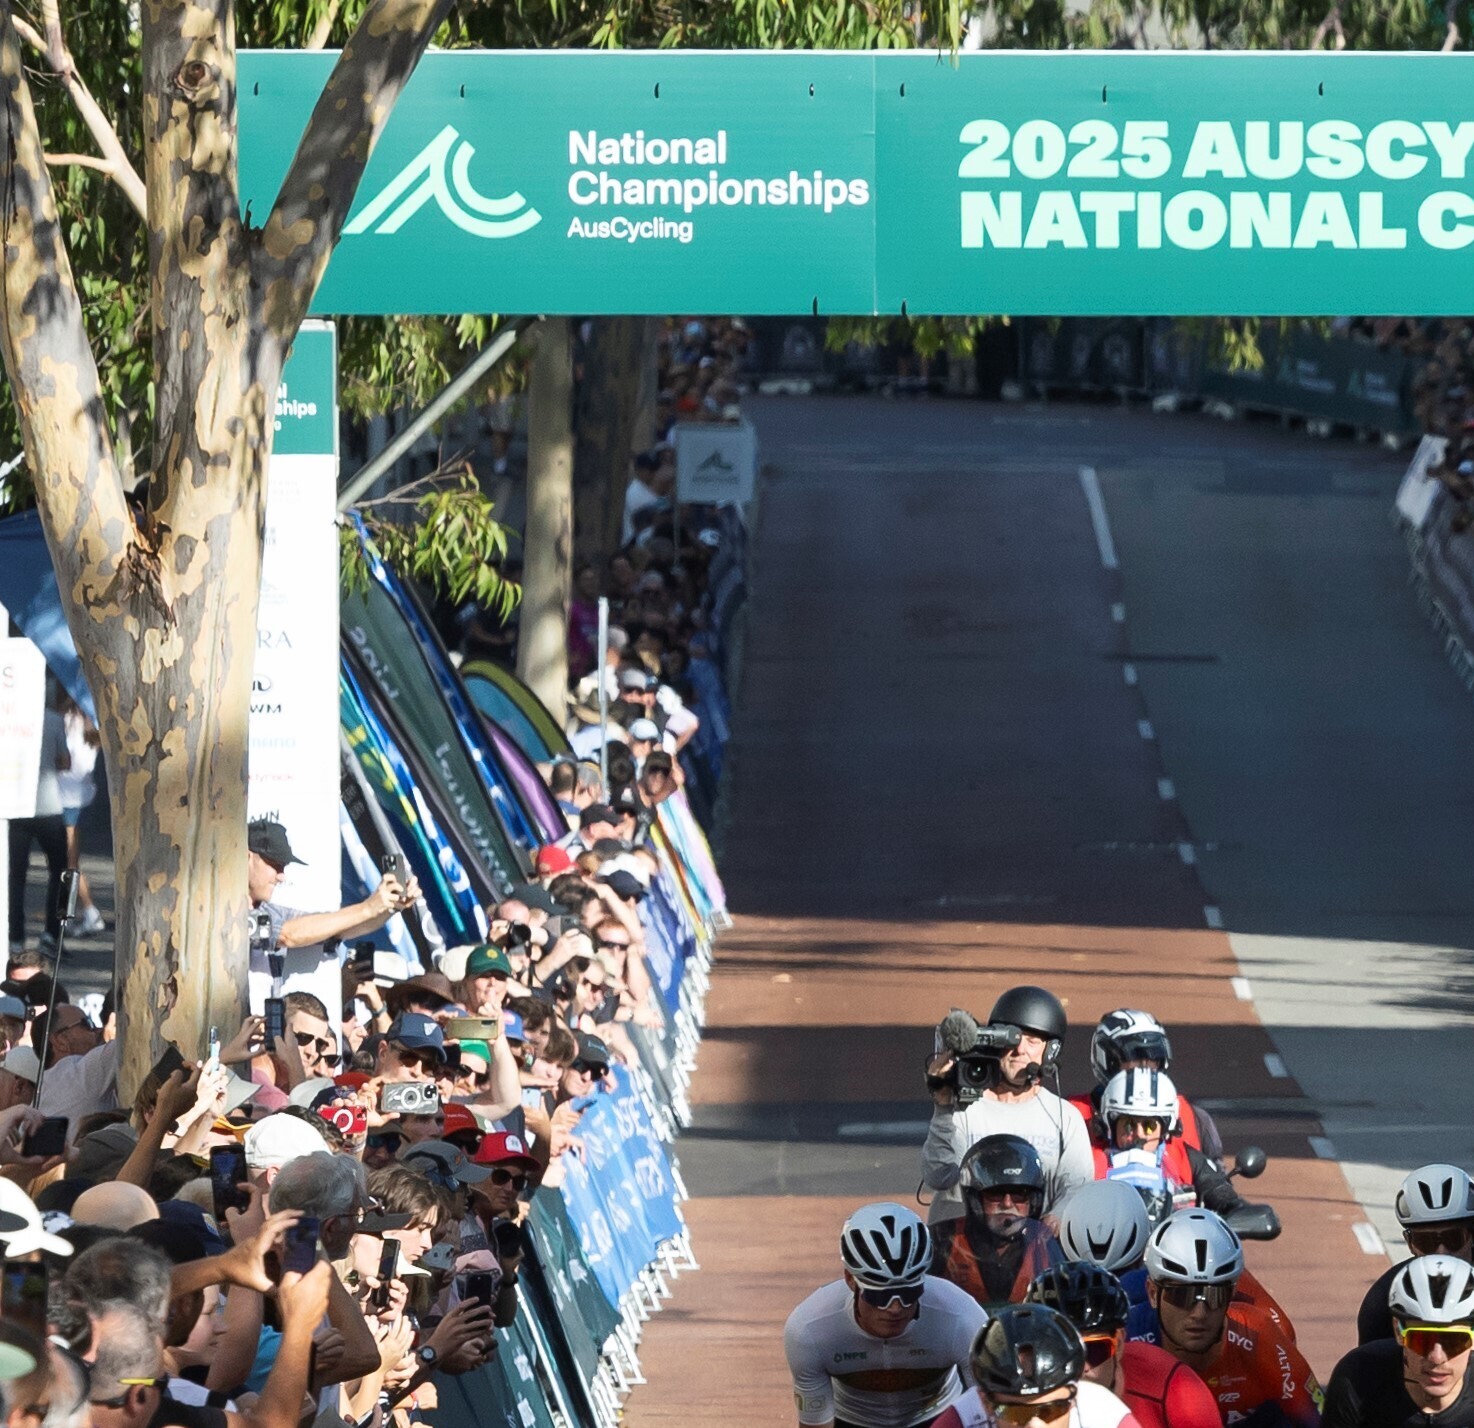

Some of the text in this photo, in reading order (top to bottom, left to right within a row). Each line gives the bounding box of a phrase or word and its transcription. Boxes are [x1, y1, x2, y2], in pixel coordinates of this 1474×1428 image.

[568, 129, 727, 165] National
[958, 119, 1172, 180] 2025
[567, 169, 870, 213] Championships
[567, 216, 693, 243] AusCycling
[960, 190, 1407, 250] NATIONAL
[1227, 1329, 1254, 1352] DYC
